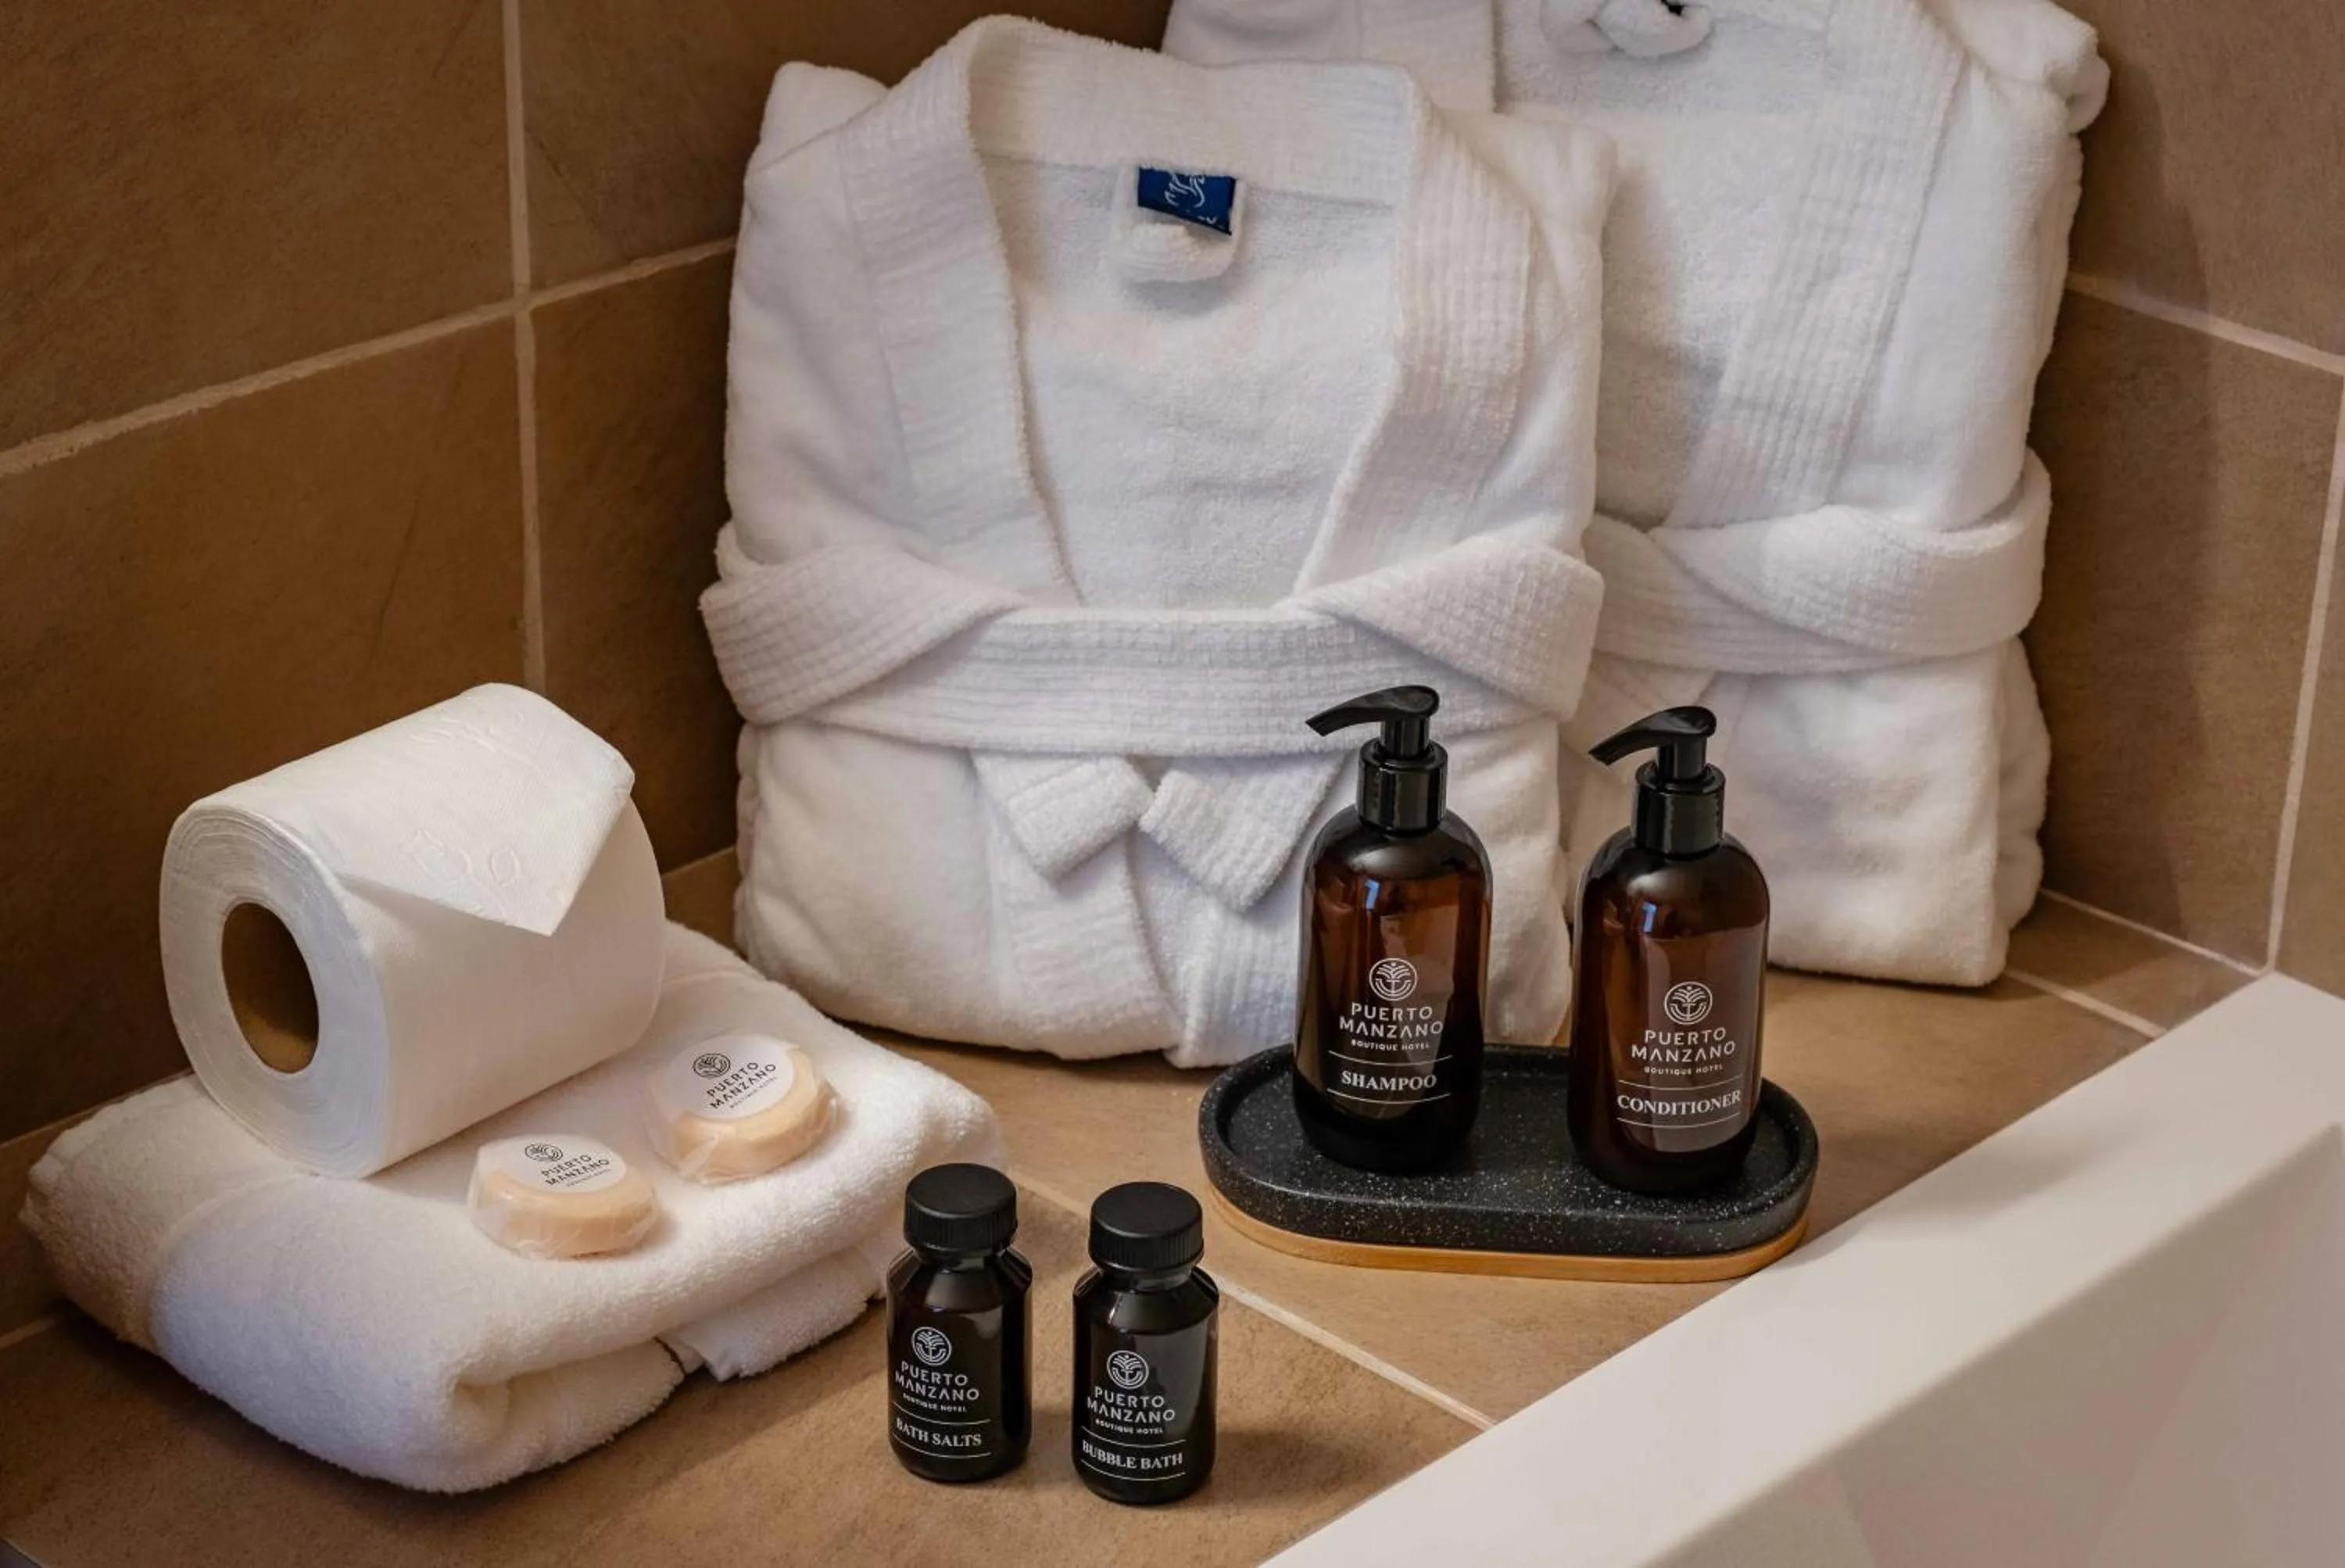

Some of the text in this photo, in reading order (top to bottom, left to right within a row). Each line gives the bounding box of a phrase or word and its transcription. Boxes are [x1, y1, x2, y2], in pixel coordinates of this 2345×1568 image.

[1351, 1002, 1433, 1022] PUERTO
[1339, 1016, 1443, 1039] MANZANO
[1644, 1027, 1727, 1045] PUERTO
[1351, 1039, 1430, 1051] BOUTIQUE HOTEL
[1631, 1040, 1736, 1062] MANZANO
[707, 1062, 758, 1097] PUERTO
[1341, 1070, 1437, 1091] SHAMPOO
[1644, 1063, 1723, 1076] BOUTIQUE HOTEL
[710, 1064, 776, 1109] MANZANO
[1616, 1090, 1742, 1115] CONDITIONER
[541, 1155, 592, 1177] PUERTO
[545, 1158, 610, 1186] MANZANO
[894, 1369, 979, 1401] MANZANO
[900, 1360, 968, 1386] PUERTO
[1094, 1386, 1164, 1408] PUERTO
[1087, 1396, 1176, 1423] MANZANO
[896, 1417, 983, 1447] BATH SALTS
[1082, 1439, 1183, 1470] BUBBLE BATH
